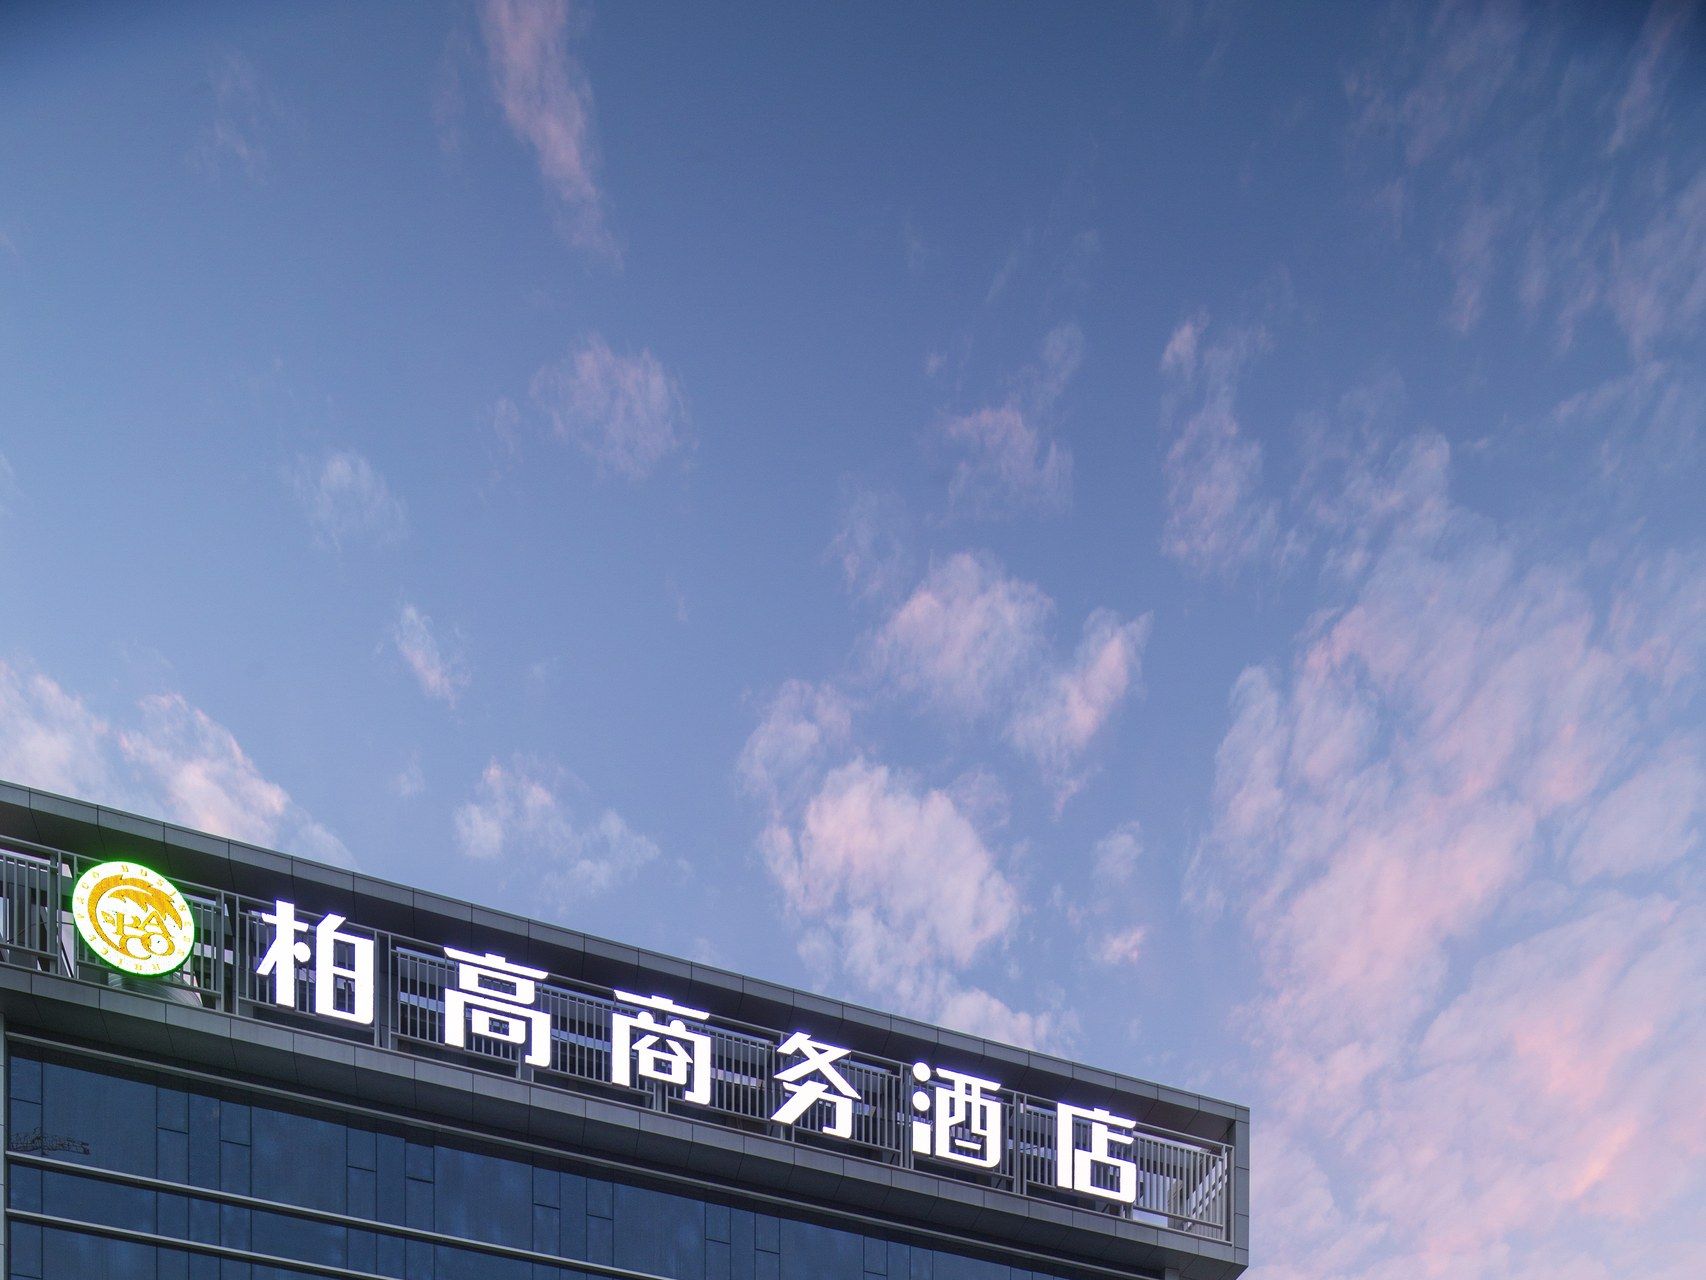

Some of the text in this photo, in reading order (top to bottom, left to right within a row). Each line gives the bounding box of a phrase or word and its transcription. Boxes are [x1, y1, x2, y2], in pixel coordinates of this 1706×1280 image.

[255, 899, 1137, 1204] 柏高商务酒店
